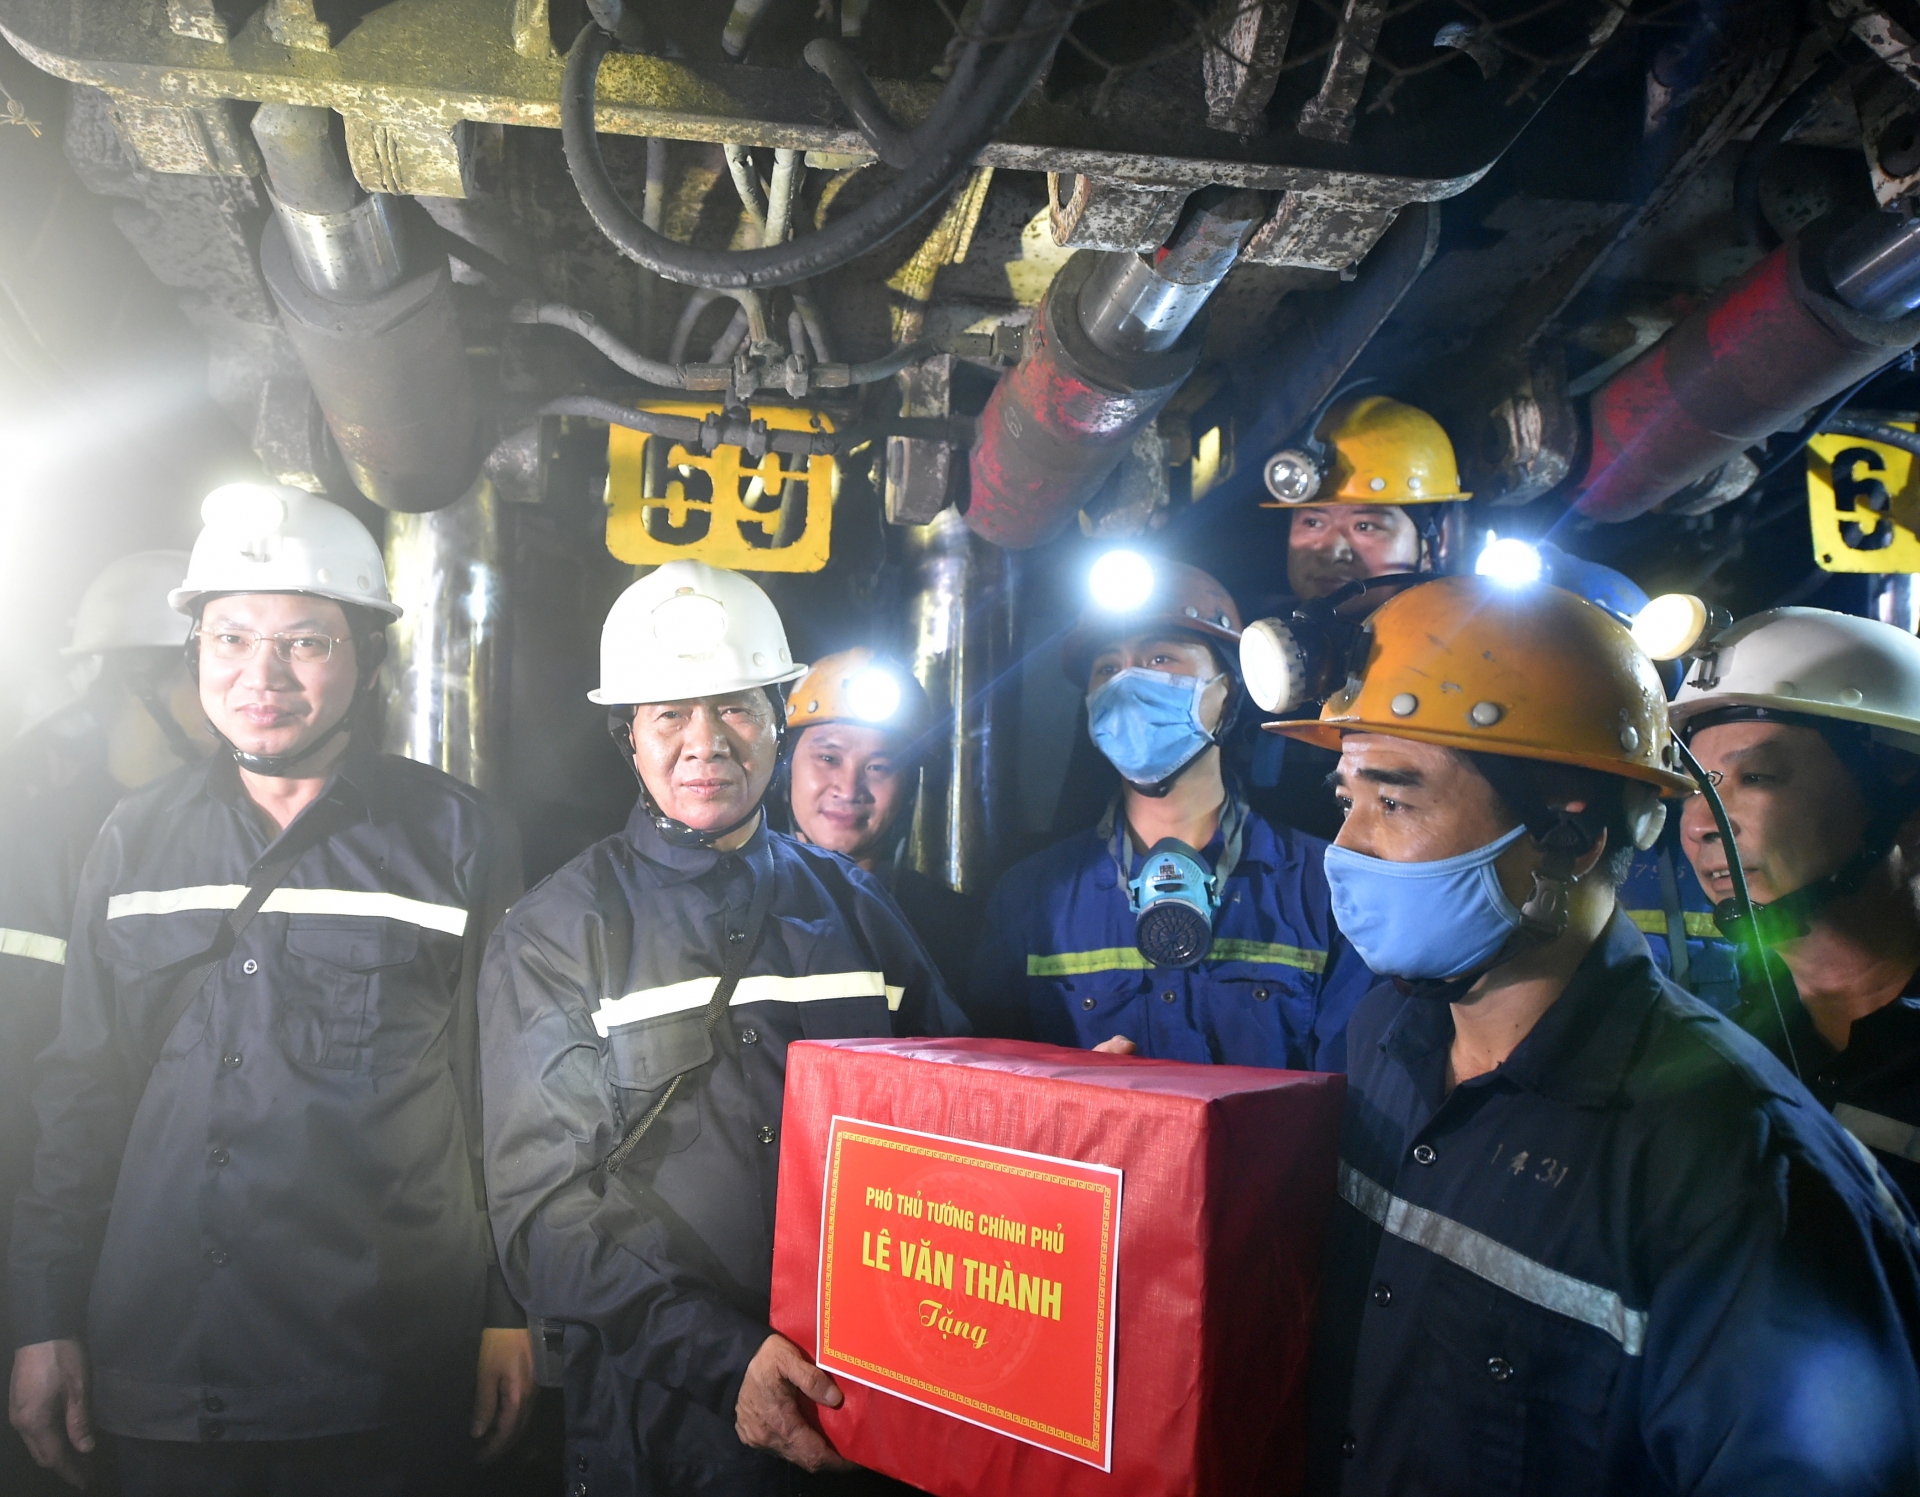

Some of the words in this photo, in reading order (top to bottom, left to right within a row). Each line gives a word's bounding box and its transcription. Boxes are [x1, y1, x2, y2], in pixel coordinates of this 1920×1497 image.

[1491, 1143, 1569, 1188] 1431
[865, 1184, 893, 1212] PHÓ
[896, 1190, 923, 1219] THỦ
[927, 1199, 974, 1232] TƯỚNG
[978, 1214, 1027, 1246] CHÍNH
[1031, 1223, 1065, 1254] PHỦ
[862, 1229, 892, 1272] LÊ
[899, 1238, 954, 1290] VĂN
[962, 1258, 1062, 1321] THÀNH
[918, 1299, 989, 1349] Tặng
